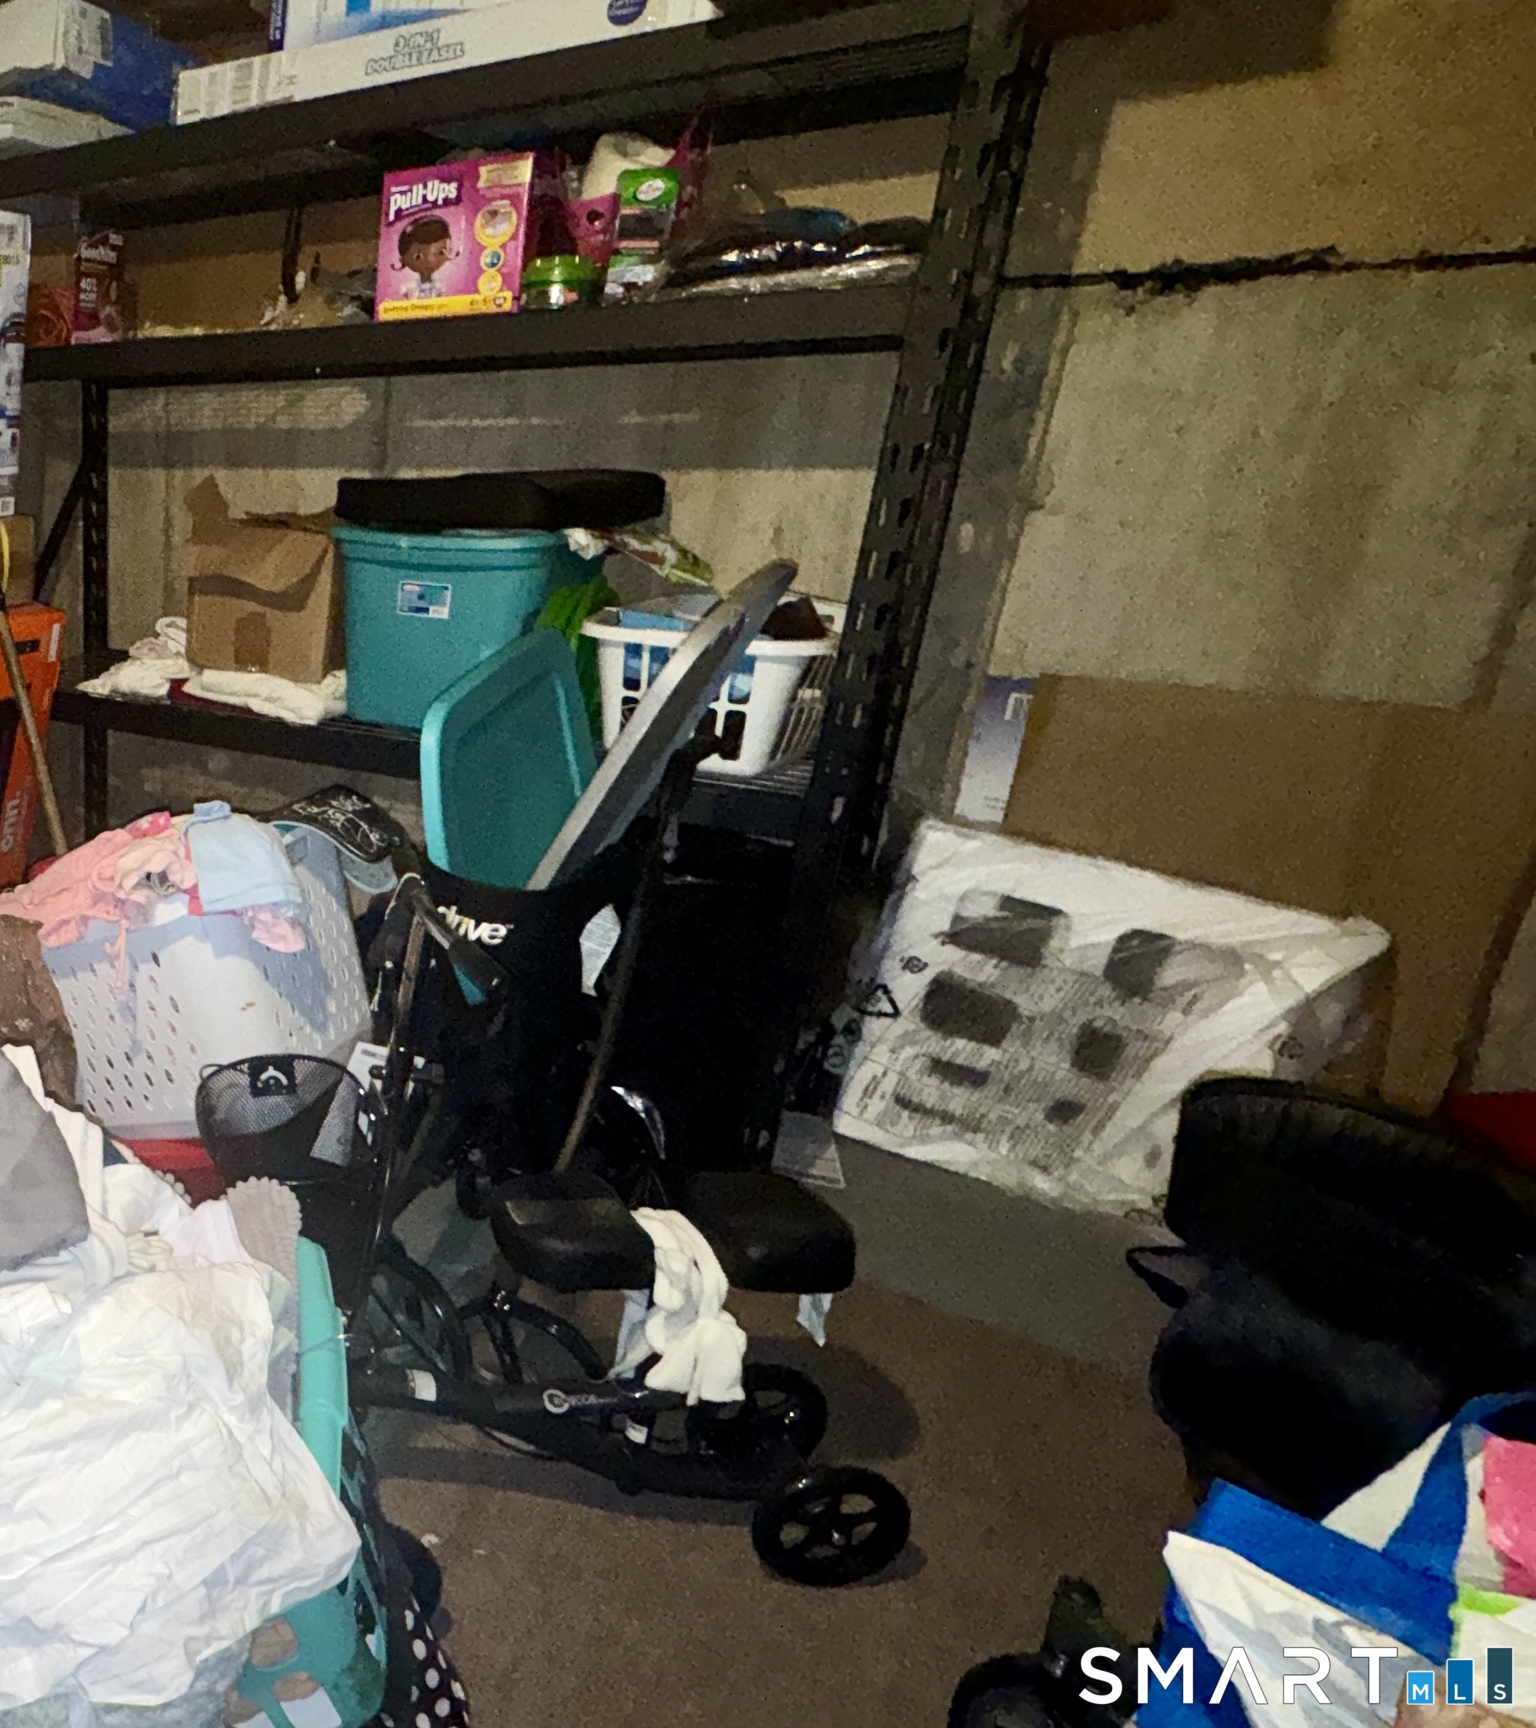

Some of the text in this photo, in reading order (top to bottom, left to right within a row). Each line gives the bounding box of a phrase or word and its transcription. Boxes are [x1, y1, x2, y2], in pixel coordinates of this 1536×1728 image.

[365, 42, 464, 75] DOUBLE EASEL
[389, 179, 458, 222] Pull-Ups
